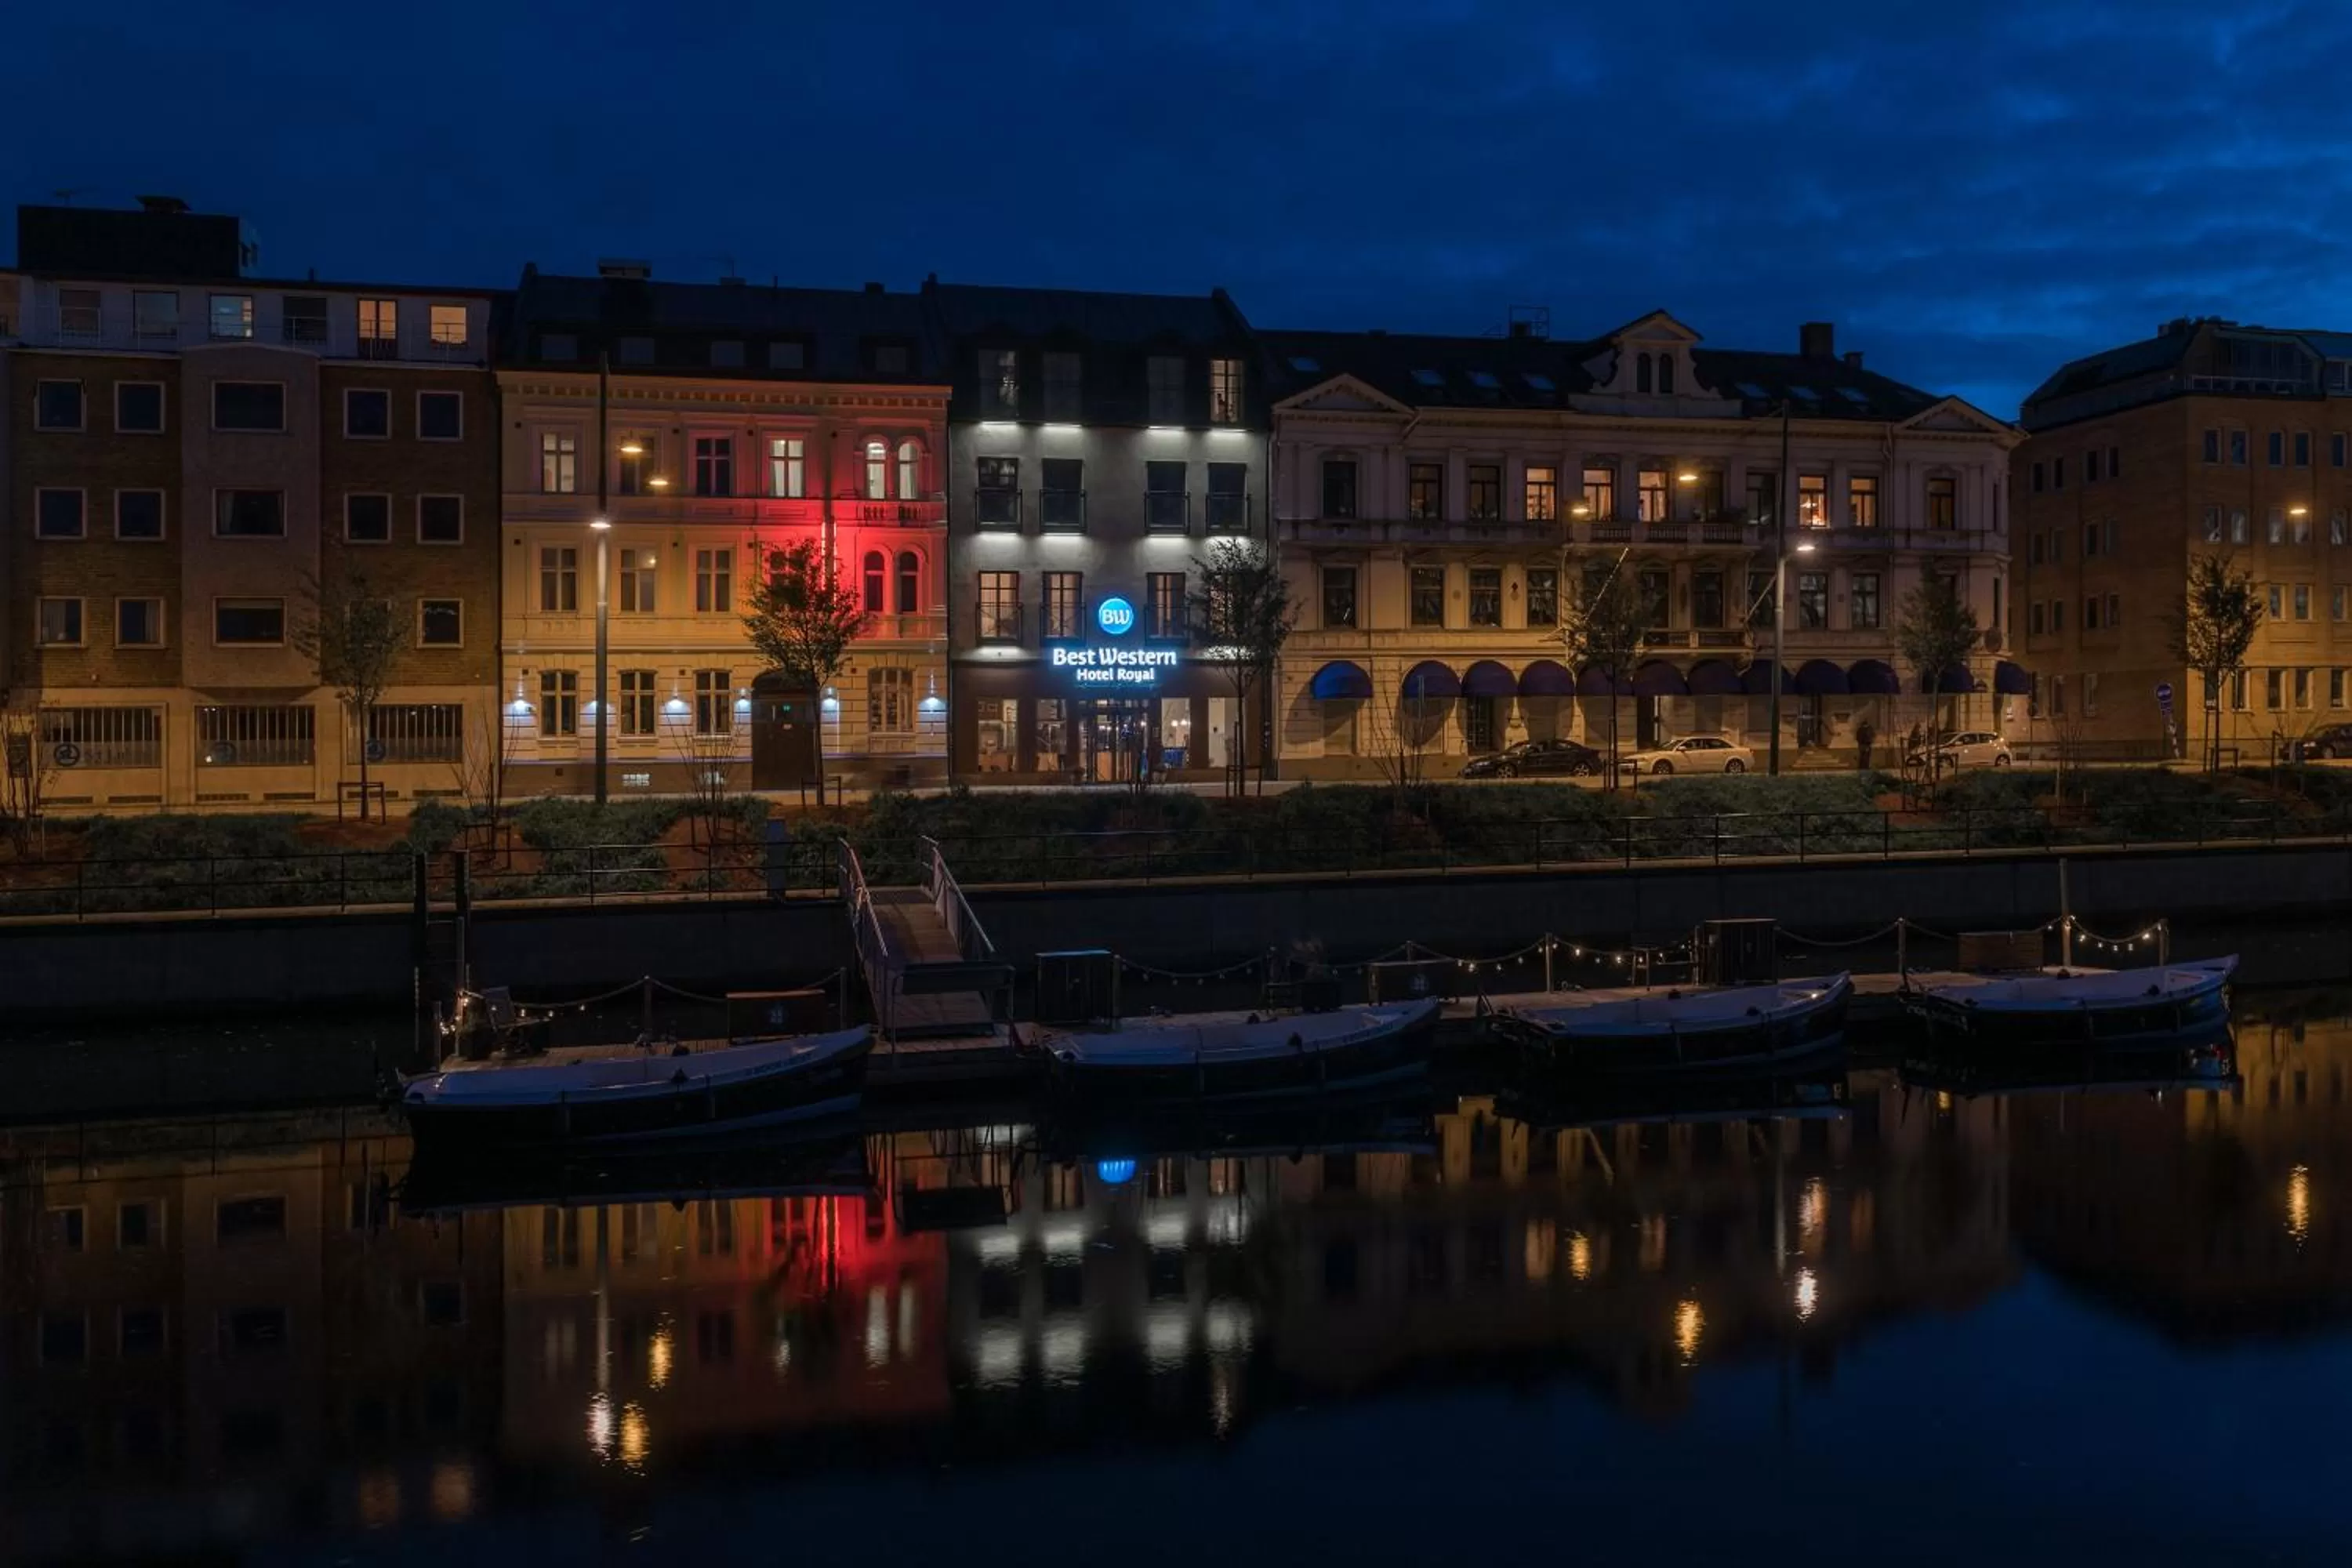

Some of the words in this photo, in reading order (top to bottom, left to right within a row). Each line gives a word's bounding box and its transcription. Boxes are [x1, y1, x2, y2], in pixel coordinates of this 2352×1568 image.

[1102, 609, 1130, 625] BW
[1053, 648, 1095, 665] Best
[1098, 648, 1176, 665] Western
[1076, 668, 1113, 681] Hotel
[1117, 668, 1154, 682] Royal
